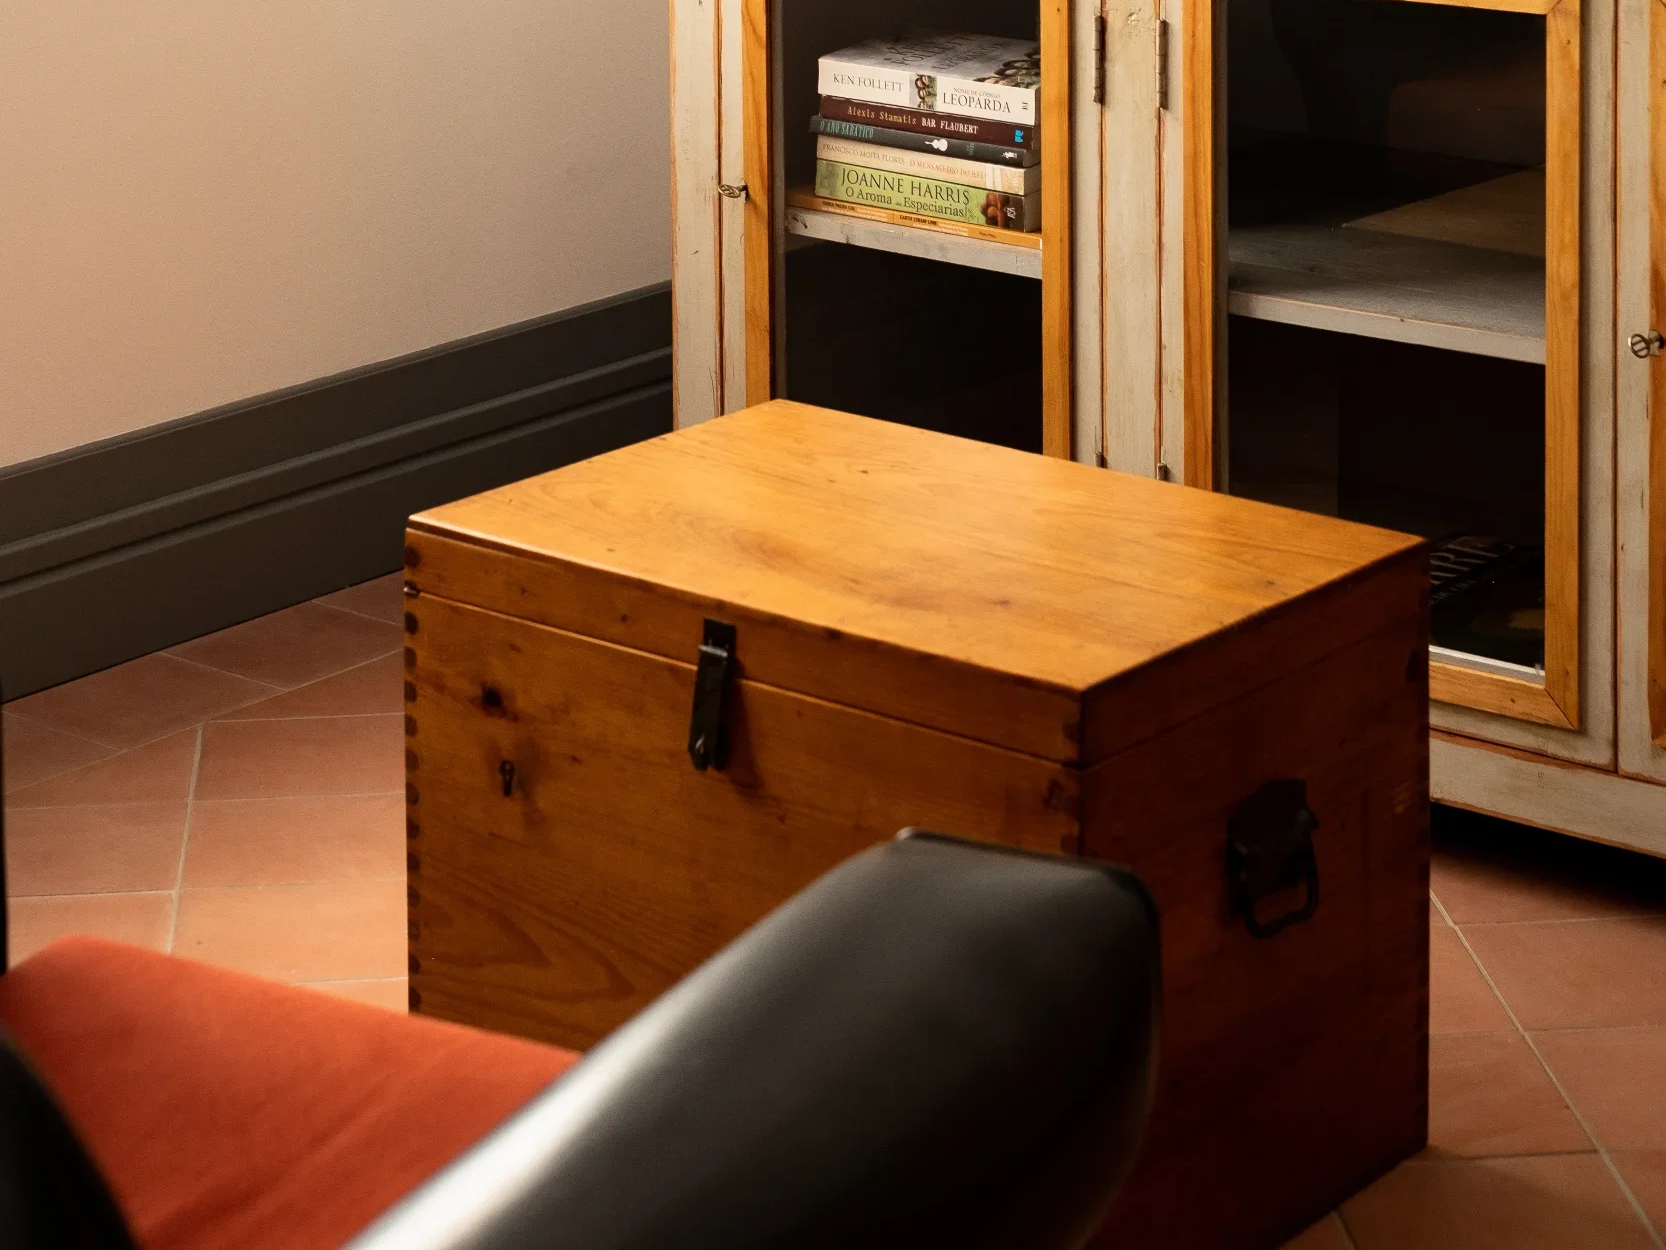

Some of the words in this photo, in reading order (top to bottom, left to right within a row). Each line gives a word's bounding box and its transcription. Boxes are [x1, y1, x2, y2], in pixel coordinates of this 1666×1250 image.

[833, 73, 855, 86] KEN
[858, 76, 904, 92] FOLLETT
[943, 92, 1011, 113] LEOPARDA
[848, 107, 875, 119] Alexis
[879, 111, 917, 125] Stamatis
[820, 120, 825, 130] O
[827, 122, 840, 134] ANO
[921, 118, 936, 128] BAR
[940, 120, 979, 135] FLAUBERT
[823, 143, 859, 156] FRANCISCO
[860, 151, 881, 161] MOITA
[882, 154, 905, 165] FLORES
[960, 169, 970, 177] DO
[841, 168, 904, 194] JOANNE
[911, 181, 970, 206] HARRIS
[846, 187, 854, 198] O
[856, 189, 892, 205] Aroma
[904, 197, 964, 218] Especiarias
